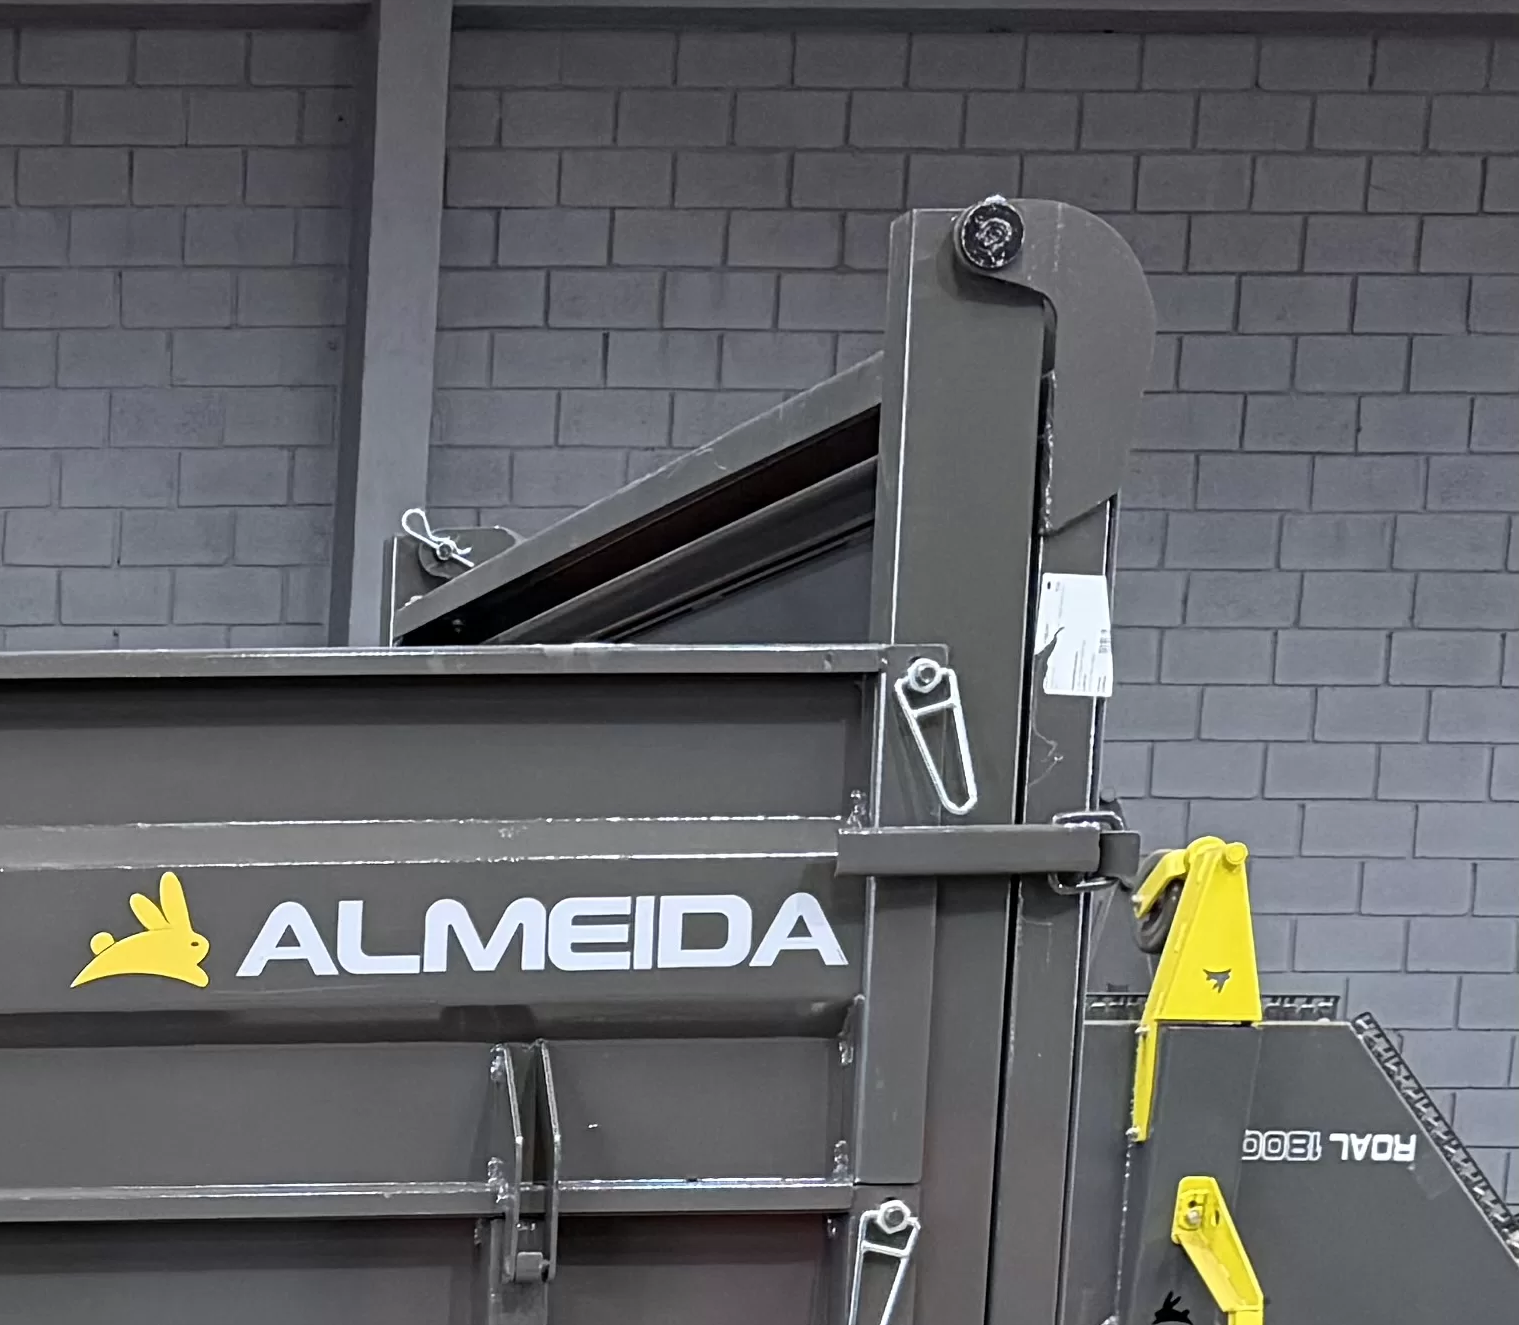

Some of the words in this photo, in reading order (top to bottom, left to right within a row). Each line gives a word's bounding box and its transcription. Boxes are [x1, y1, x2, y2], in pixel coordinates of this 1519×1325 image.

[235, 890, 849, 977] ALMEIDA
[1241, 1129, 1322, 1162] 1800
[1330, 1132, 1417, 1162] ROAL
